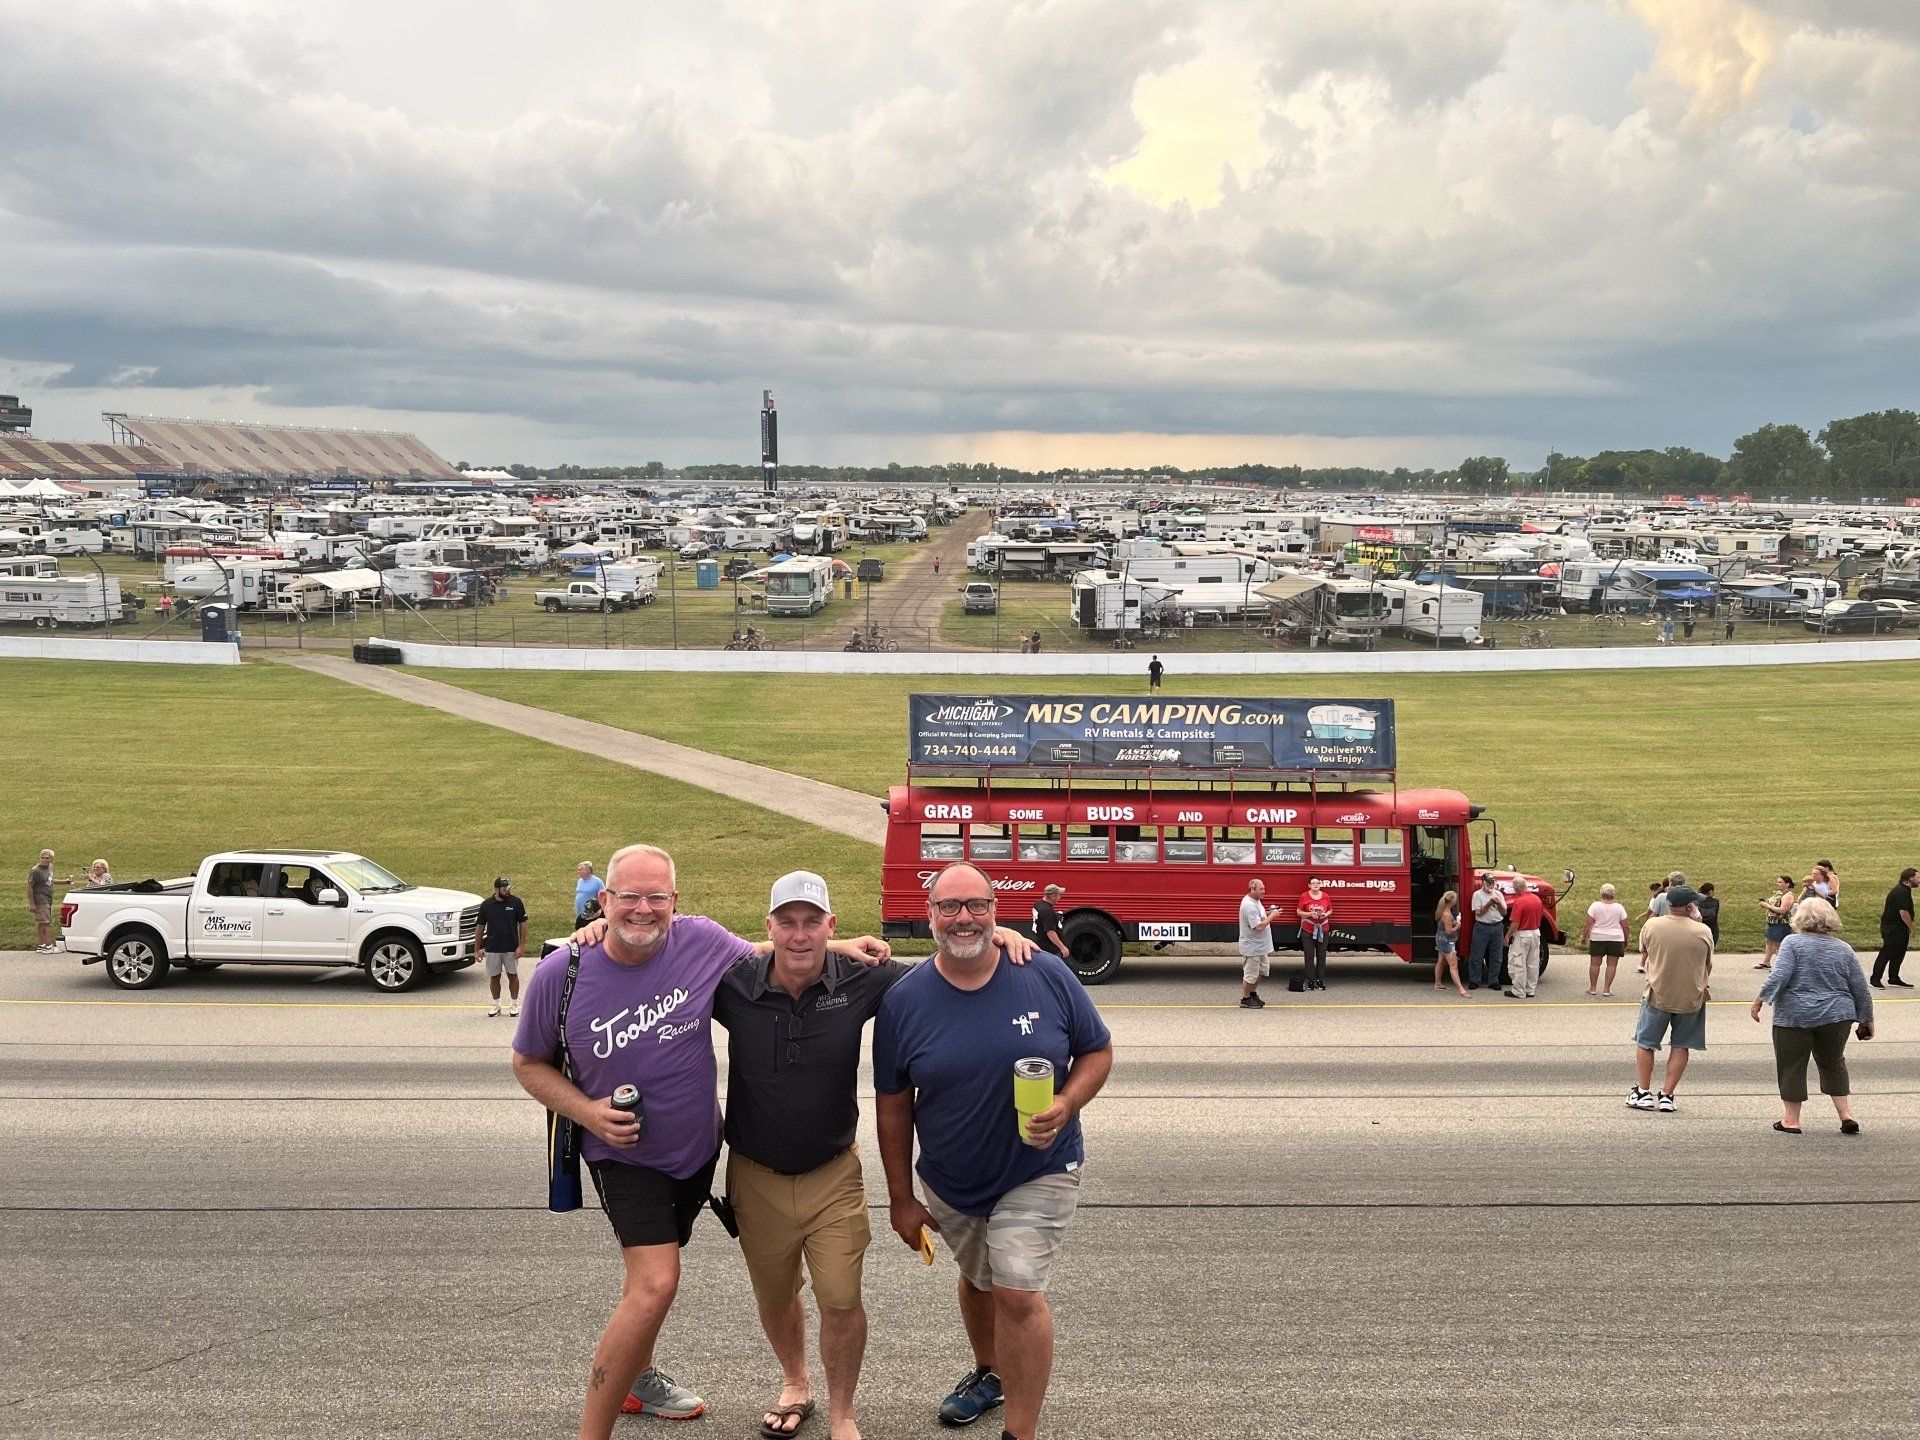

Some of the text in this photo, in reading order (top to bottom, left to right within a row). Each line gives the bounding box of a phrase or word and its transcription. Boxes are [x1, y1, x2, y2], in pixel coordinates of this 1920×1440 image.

[937, 705, 999, 721] MICHIGAN
[1023, 703, 1084, 724] MIS
[949, 731, 968, 739] Rental
[974, 732, 1000, 740] Camping
[1000, 732, 1025, 740] Sponsor
[1084, 728, 1216, 741] RV Rentals & Campsites
[923, 745, 1017, 756] 734-740-4444
[1304, 745, 1319, 754] We
[1320, 745, 1354, 754] Deliver
[1317, 755, 1365, 764] You Enjoy.
[923, 804, 1298, 824] GRAB SOME BUDS AND CAMP
[804, 882, 823, 897] CAT
[1366, 880, 1396, 888] BUDS
[206, 916, 226, 924] MIS
[204, 923, 252, 931] CAMPING
[1141, 926, 1175, 937] Mobil
[815, 995, 848, 1008] CAMPING
[590, 987, 689, 1059] Tootsies
[657, 1018, 700, 1043] Racing
